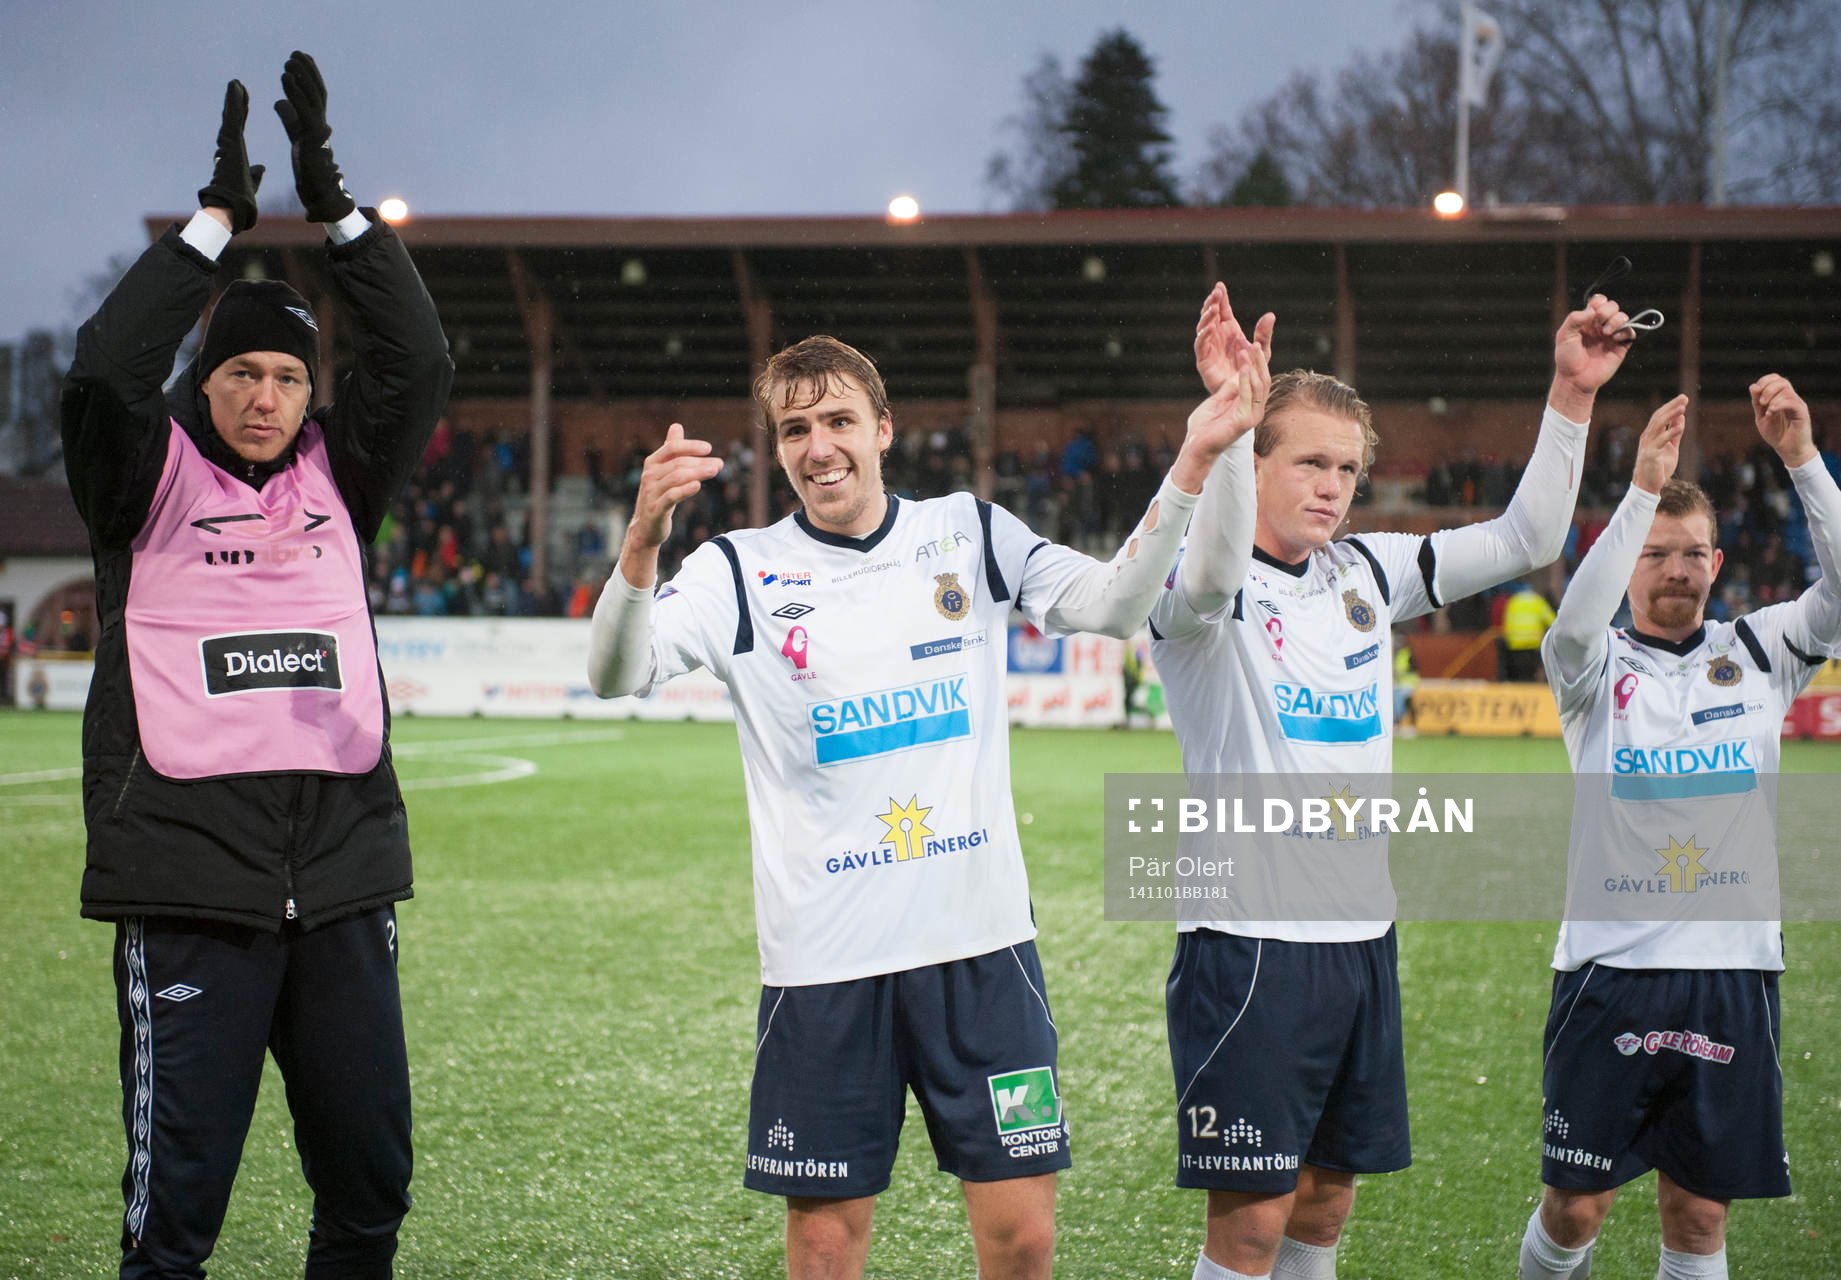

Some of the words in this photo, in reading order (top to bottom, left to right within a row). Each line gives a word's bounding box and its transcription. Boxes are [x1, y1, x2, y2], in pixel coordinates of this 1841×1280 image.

[916, 531, 972, 562] ATEA
[779, 571, 811, 580] INTER
[781, 579, 812, 587] SPORT
[924, 640, 962, 655] Danske
[224, 649, 326, 677] Dialect
[812, 677, 967, 735] SANDVIK
[1614, 741, 1750, 774] SANDVIK
[826, 849, 893, 874] GÄVLE
[1605, 875, 1666, 893] GÄVLE
[1187, 1105, 1219, 1139] 12
[1001, 1128, 1062, 1147] KONTORS
[1009, 1141, 1059, 1158] CENTER
